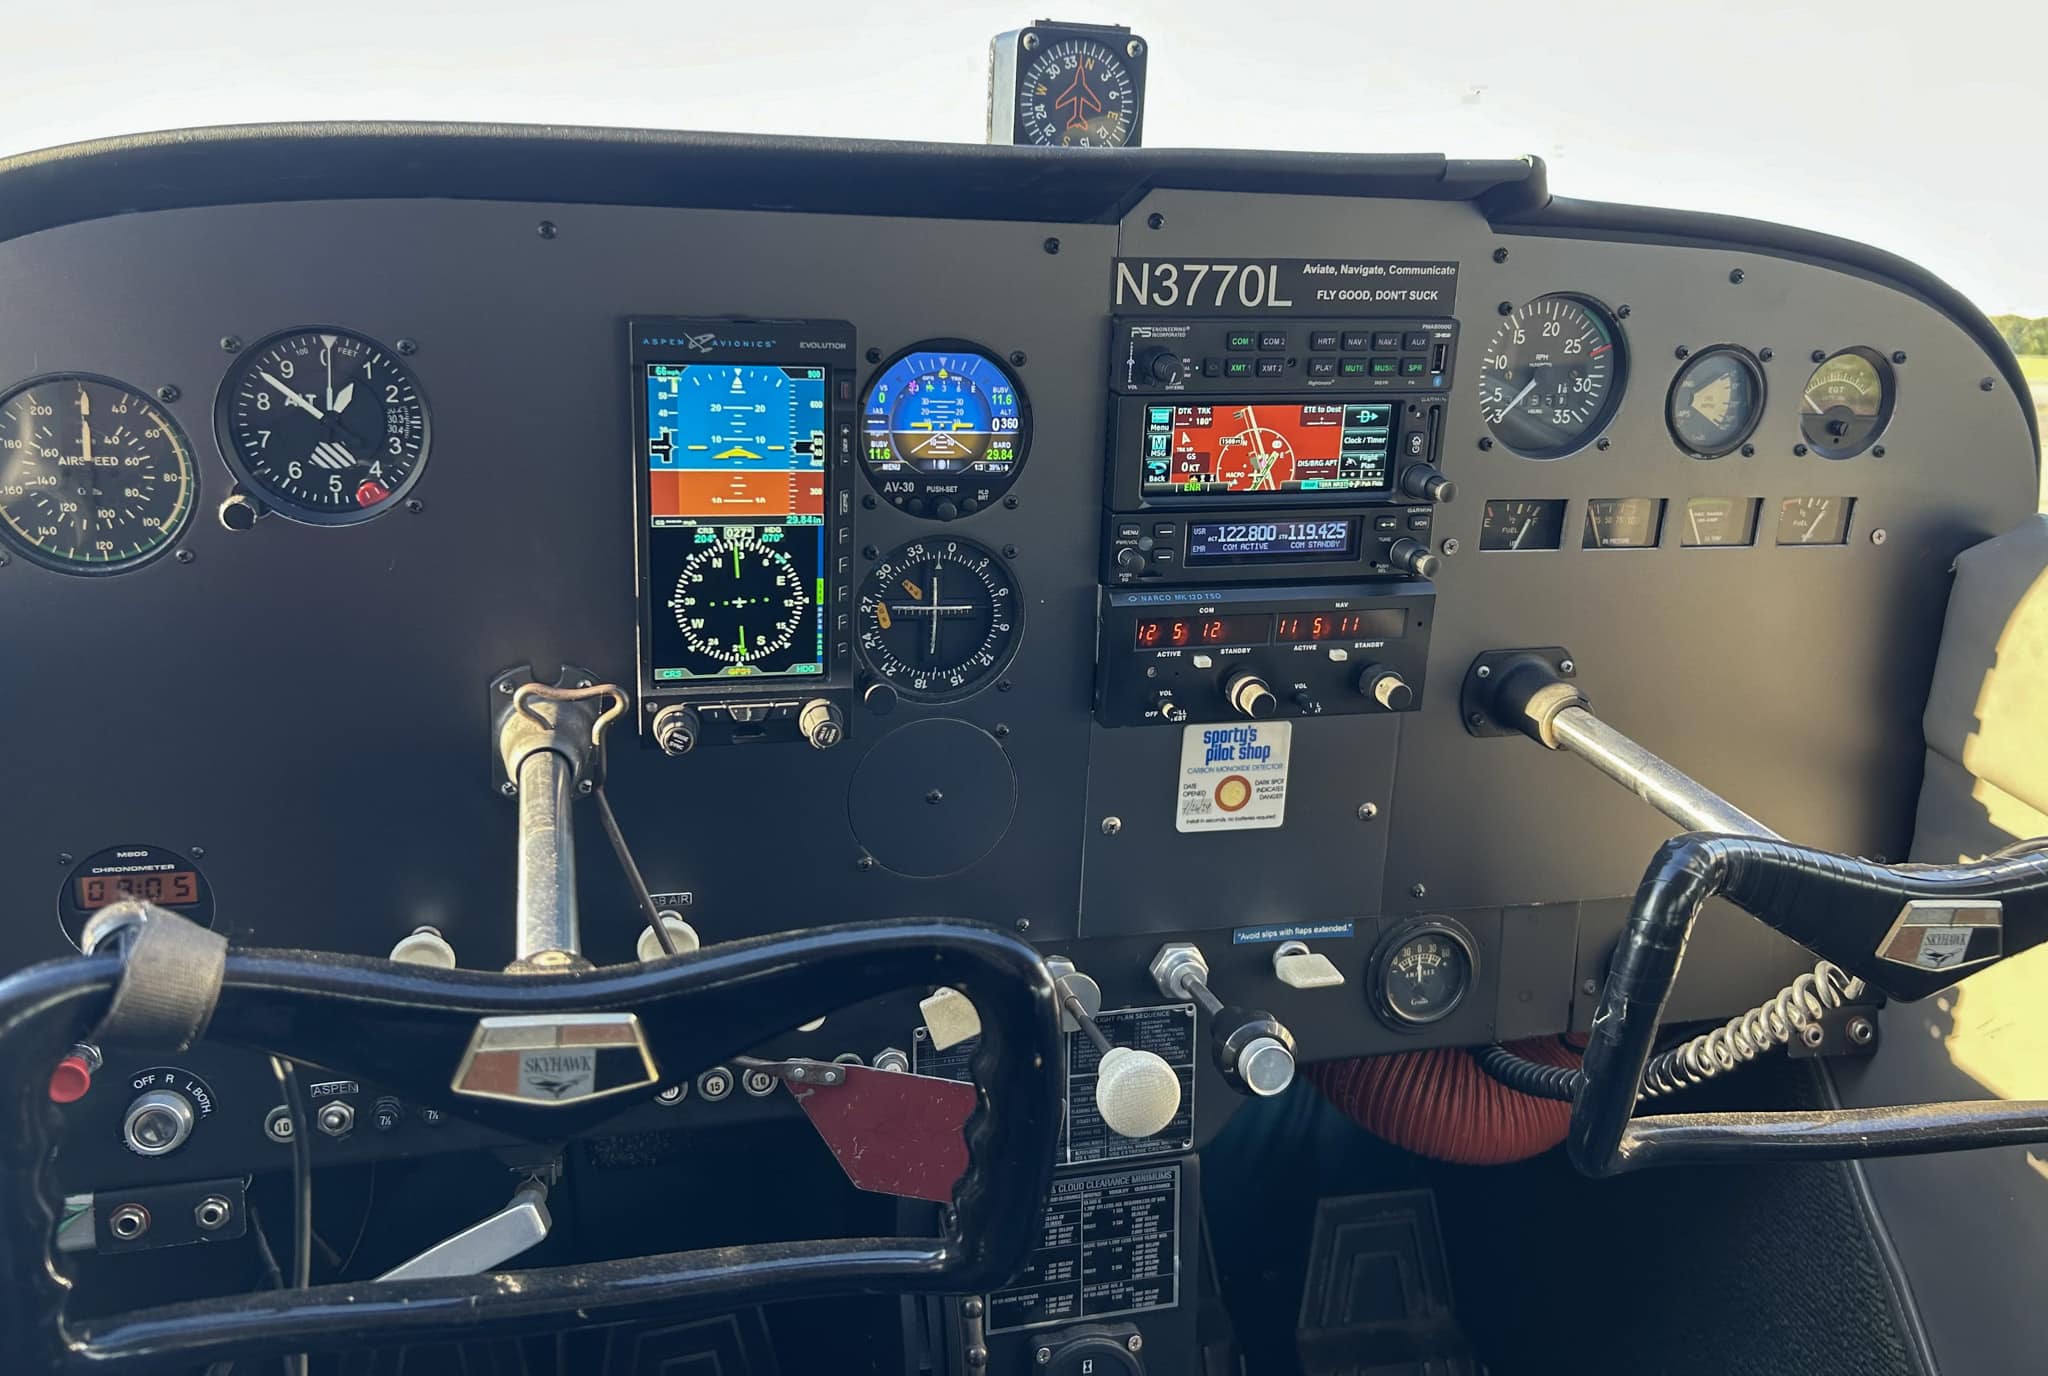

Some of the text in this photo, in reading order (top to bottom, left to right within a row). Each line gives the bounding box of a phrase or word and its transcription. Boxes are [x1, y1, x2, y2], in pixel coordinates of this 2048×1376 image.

[1064, 56, 1077, 69] 33
[1303, 263, 1456, 277] Aviate, Navigate, Communicate
[1115, 263, 1292, 307] N3770L
[1317, 289, 1438, 302] FLY GOOD, DON'T SUCK
[1542, 322, 1560, 337] 20
[643, 338, 685, 346] ASPEN
[1513, 330, 1526, 344] 15
[337, 347, 358, 358] FEET
[1564, 339, 1582, 353] 25
[1231, 364, 1246, 372] XMT
[1495, 355, 1507, 369] 10
[280, 360, 294, 379] 9
[363, 362, 372, 380] 1
[1573, 378, 1592, 392] 30
[1828, 386, 1844, 394] EGT
[385, 385, 399, 403] 2
[992, 394, 1012, 405] 11.6
[1493, 388, 1502, 402] 5
[257, 393, 270, 410] 8
[30, 406, 52, 416] 200
[112, 405, 127, 414] 40
[1553, 410, 1571, 423] 35
[104, 436, 119, 445] 40
[145, 430, 160, 438] 60
[258, 431, 271, 448] 7
[1367, 436, 1386, 444] Timer
[3, 440, 22, 449] 180
[389, 437, 402, 455] 3
[40, 449, 59, 457] 160
[868, 448, 891, 460] 11.6
[987, 449, 1013, 460] 29.84
[58, 456, 119, 466] AIRSEED
[125, 457, 139, 466] 60
[288, 462, 302, 479] 6
[369, 461, 383, 477] 4
[37, 476, 57, 485] 140
[163, 473, 177, 482] 80
[329, 475, 342, 492] 5
[4, 487, 23, 495] 160
[125, 489, 139, 497] 80
[884, 482, 914, 492] AV-30
[60, 504, 77, 512] 120
[97, 510, 115, 518] 100
[143, 518, 160, 527] 100
[38, 527, 57, 535] 140
[1288, 524, 1346, 541] 119.425
[96, 542, 113, 550] 120
[907, 544, 924, 557] 33
[948, 542, 957, 552] 0
[876, 563, 892, 580] 30
[861, 596, 873, 613] 27
[862, 632, 875, 649] 24
[1204, 725, 1258, 747] sporty's
[1205, 743, 1270, 766] pilot shop
[92, 864, 175, 874] CHRONOMETER
[1237, 931, 1261, 940] "Avoid
[1262, 930, 1278, 939] slips
[1279, 928, 1294, 936] with
[1295, 927, 1313, 937] flaps
[1924, 933, 1969, 946] SKYHAWK
[524, 1056, 592, 1073] SKYHAWK
[133, 1075, 156, 1089] OFF
[165, 1073, 175, 1084] R
[185, 1081, 193, 1091] L
[312, 1084, 356, 1096] ASPEN
[1058, 1183, 1084, 1193] CLOUD
[1086, 1177, 1130, 1190] CLEARANCE
